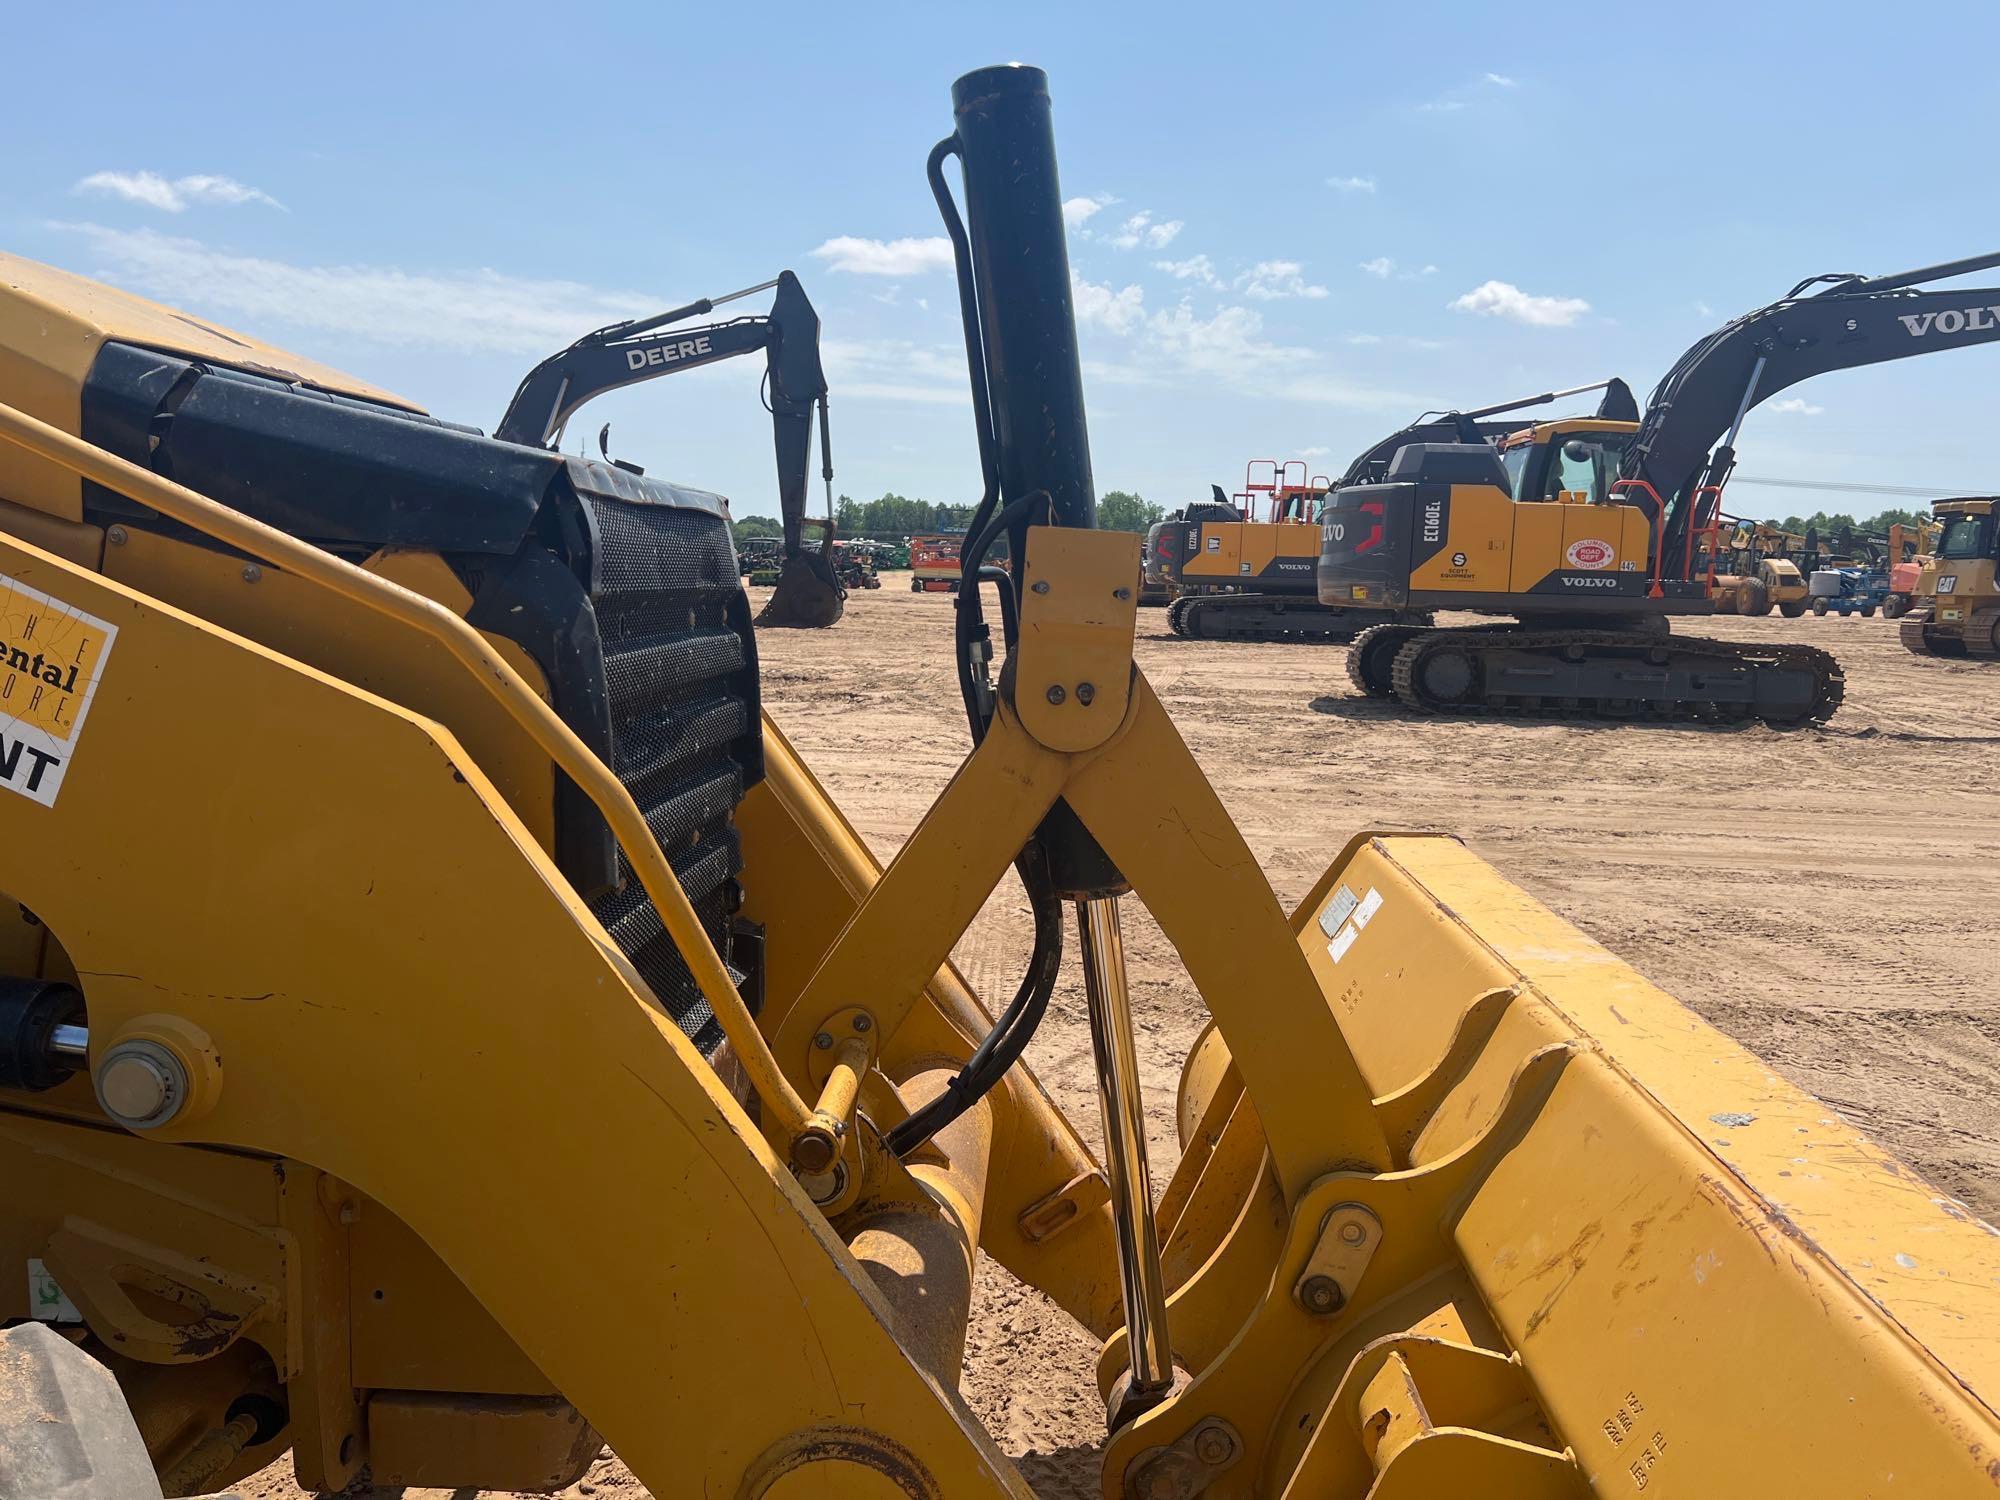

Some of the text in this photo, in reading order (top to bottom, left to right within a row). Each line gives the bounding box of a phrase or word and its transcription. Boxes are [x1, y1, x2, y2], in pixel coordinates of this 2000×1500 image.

[626, 337, 712, 370] DEERE
[1423, 501, 1440, 542] EC160EL
[1572, 540, 1610, 552] COLUMBIA
[1278, 563, 1310, 571] VOLVO
[1574, 560, 1605, 569] COUNTY
[1561, 577, 1617, 588] VOLVO
[1937, 577, 1956, 593] CAT
